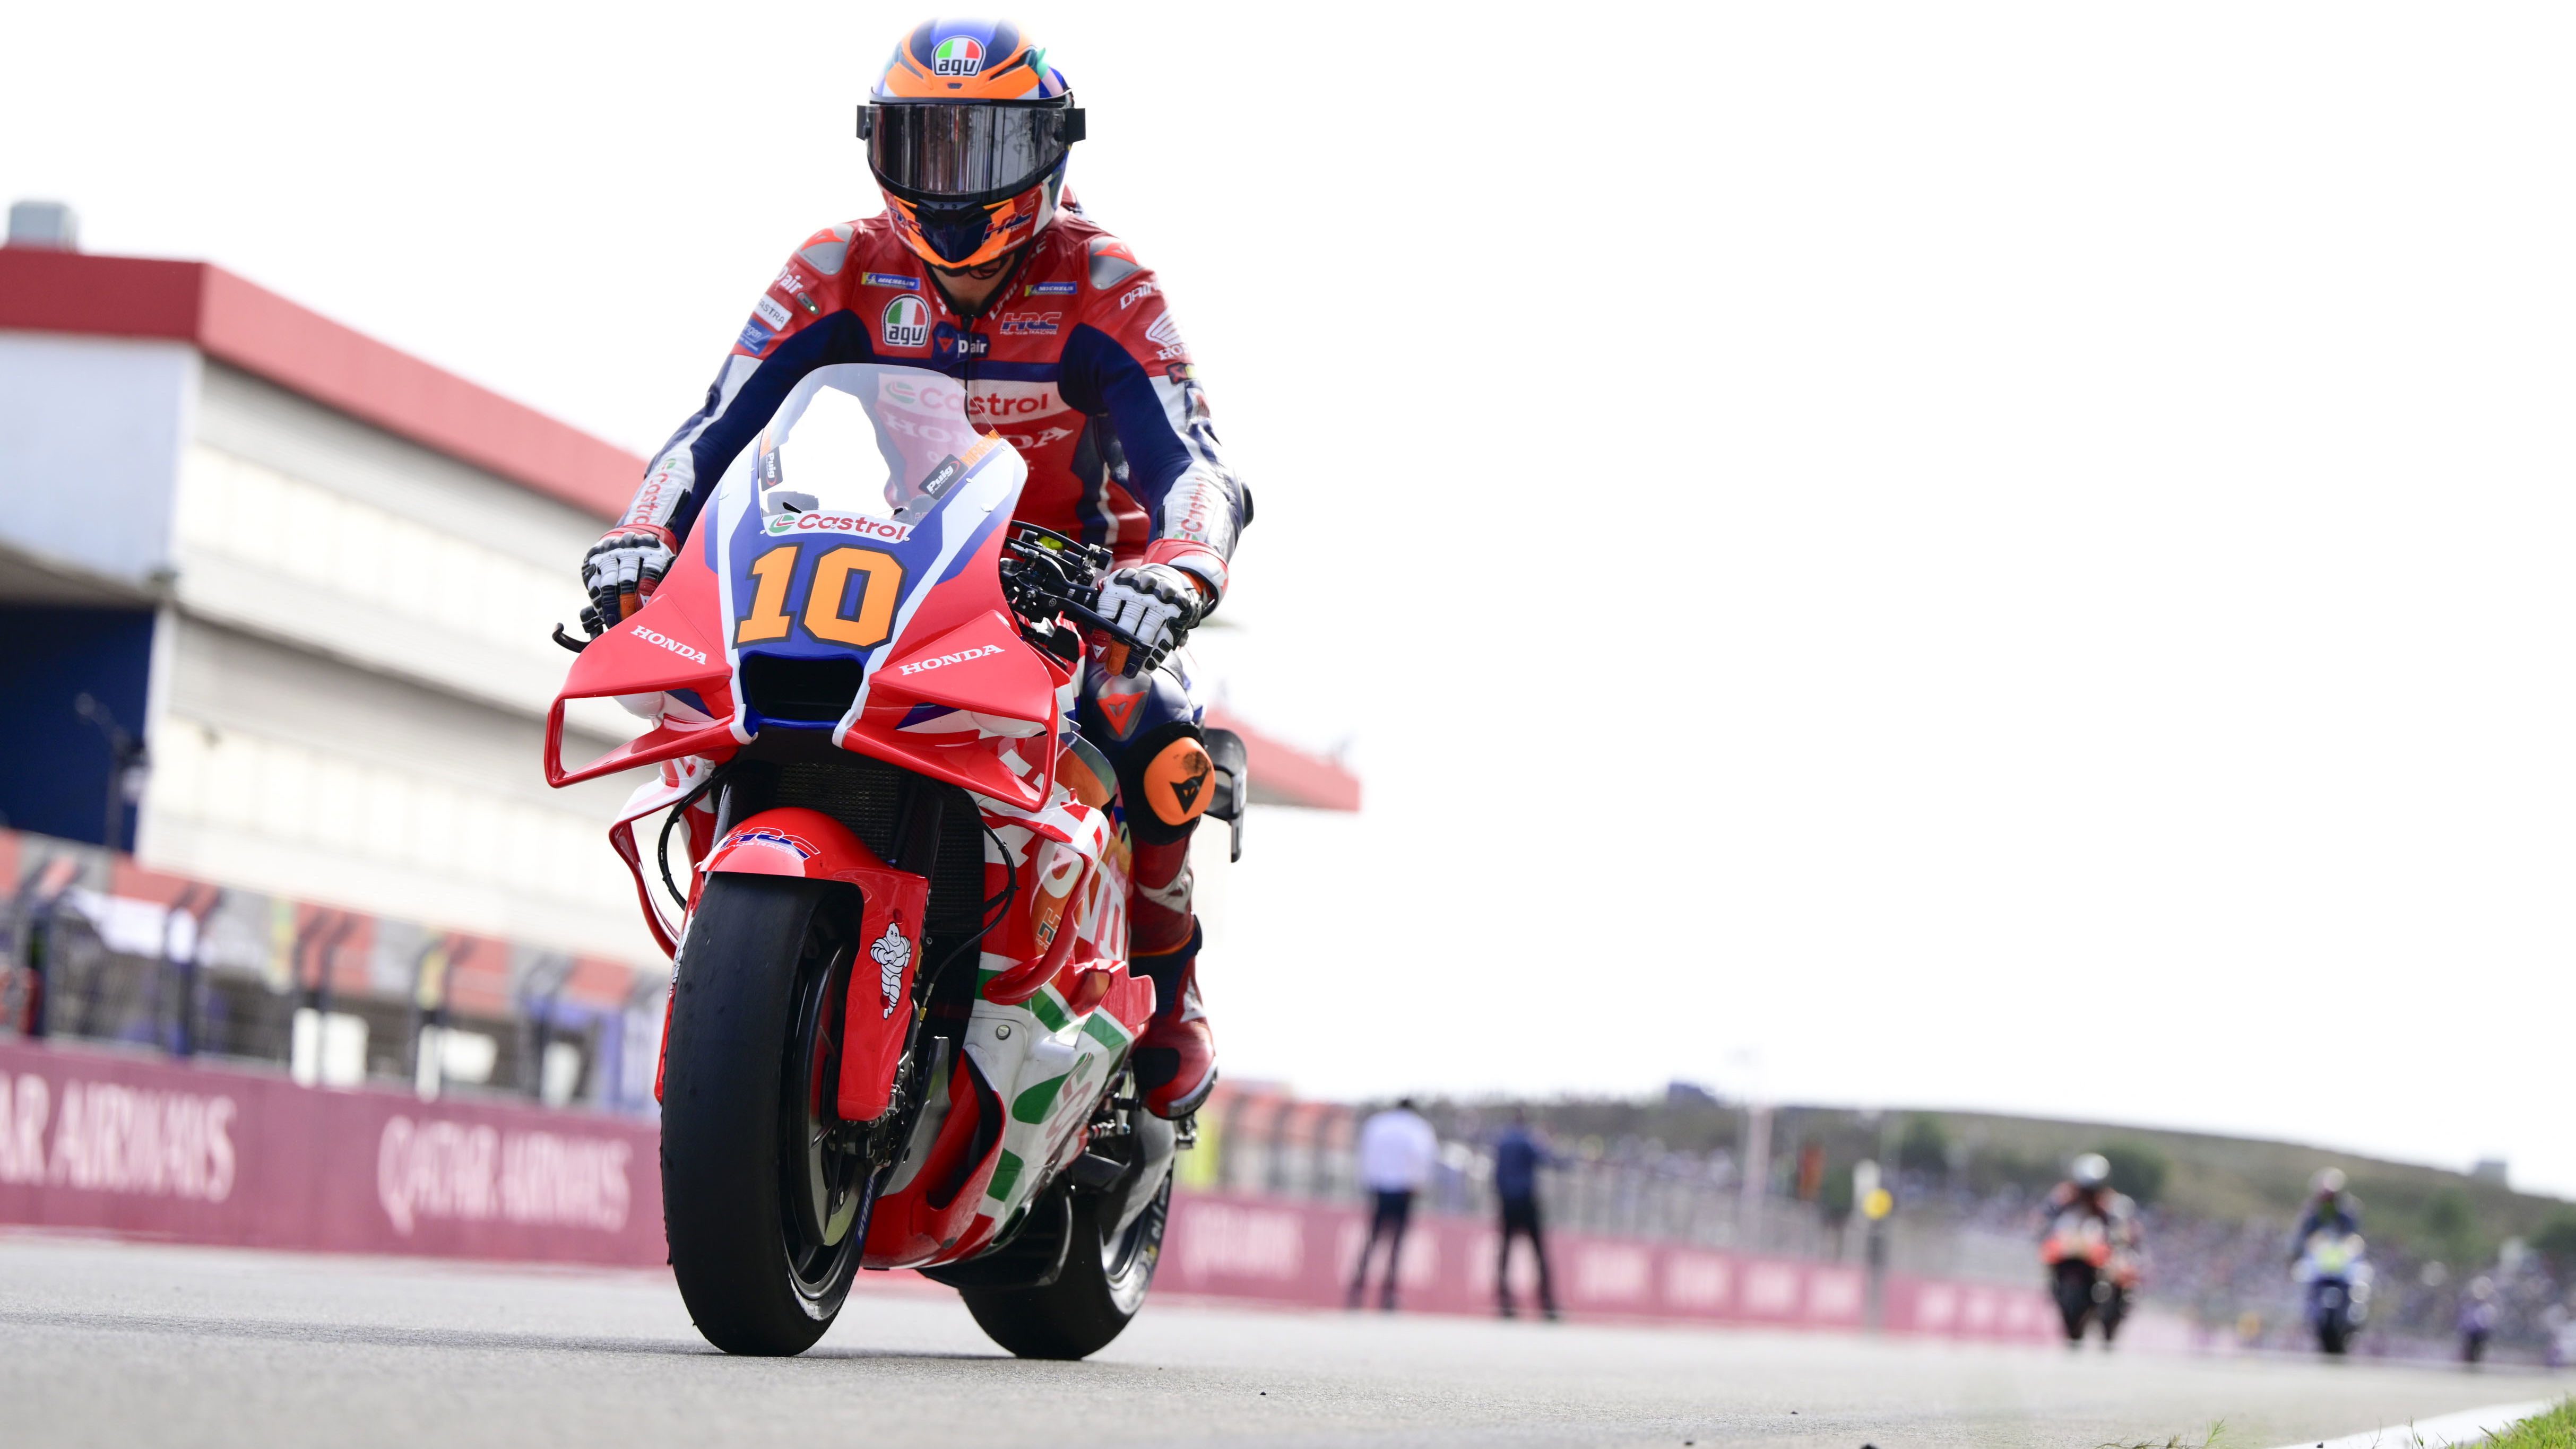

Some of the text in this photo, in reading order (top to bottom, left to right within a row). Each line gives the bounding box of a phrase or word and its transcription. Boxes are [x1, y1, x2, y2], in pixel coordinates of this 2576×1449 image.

[938, 58, 976, 76] agv
[888, 325, 923, 345] agv
[1000, 311, 1062, 331] HRC
[919, 387, 1049, 416] Castrol
[927, 465, 954, 493] Puig
[633, 473, 669, 524] Castro
[797, 513, 909, 541] Castrol
[732, 543, 909, 653] 10
[630, 625, 707, 665] HONDA
[898, 644, 1006, 675] HONDA
[719, 841, 805, 863] onda RACING
